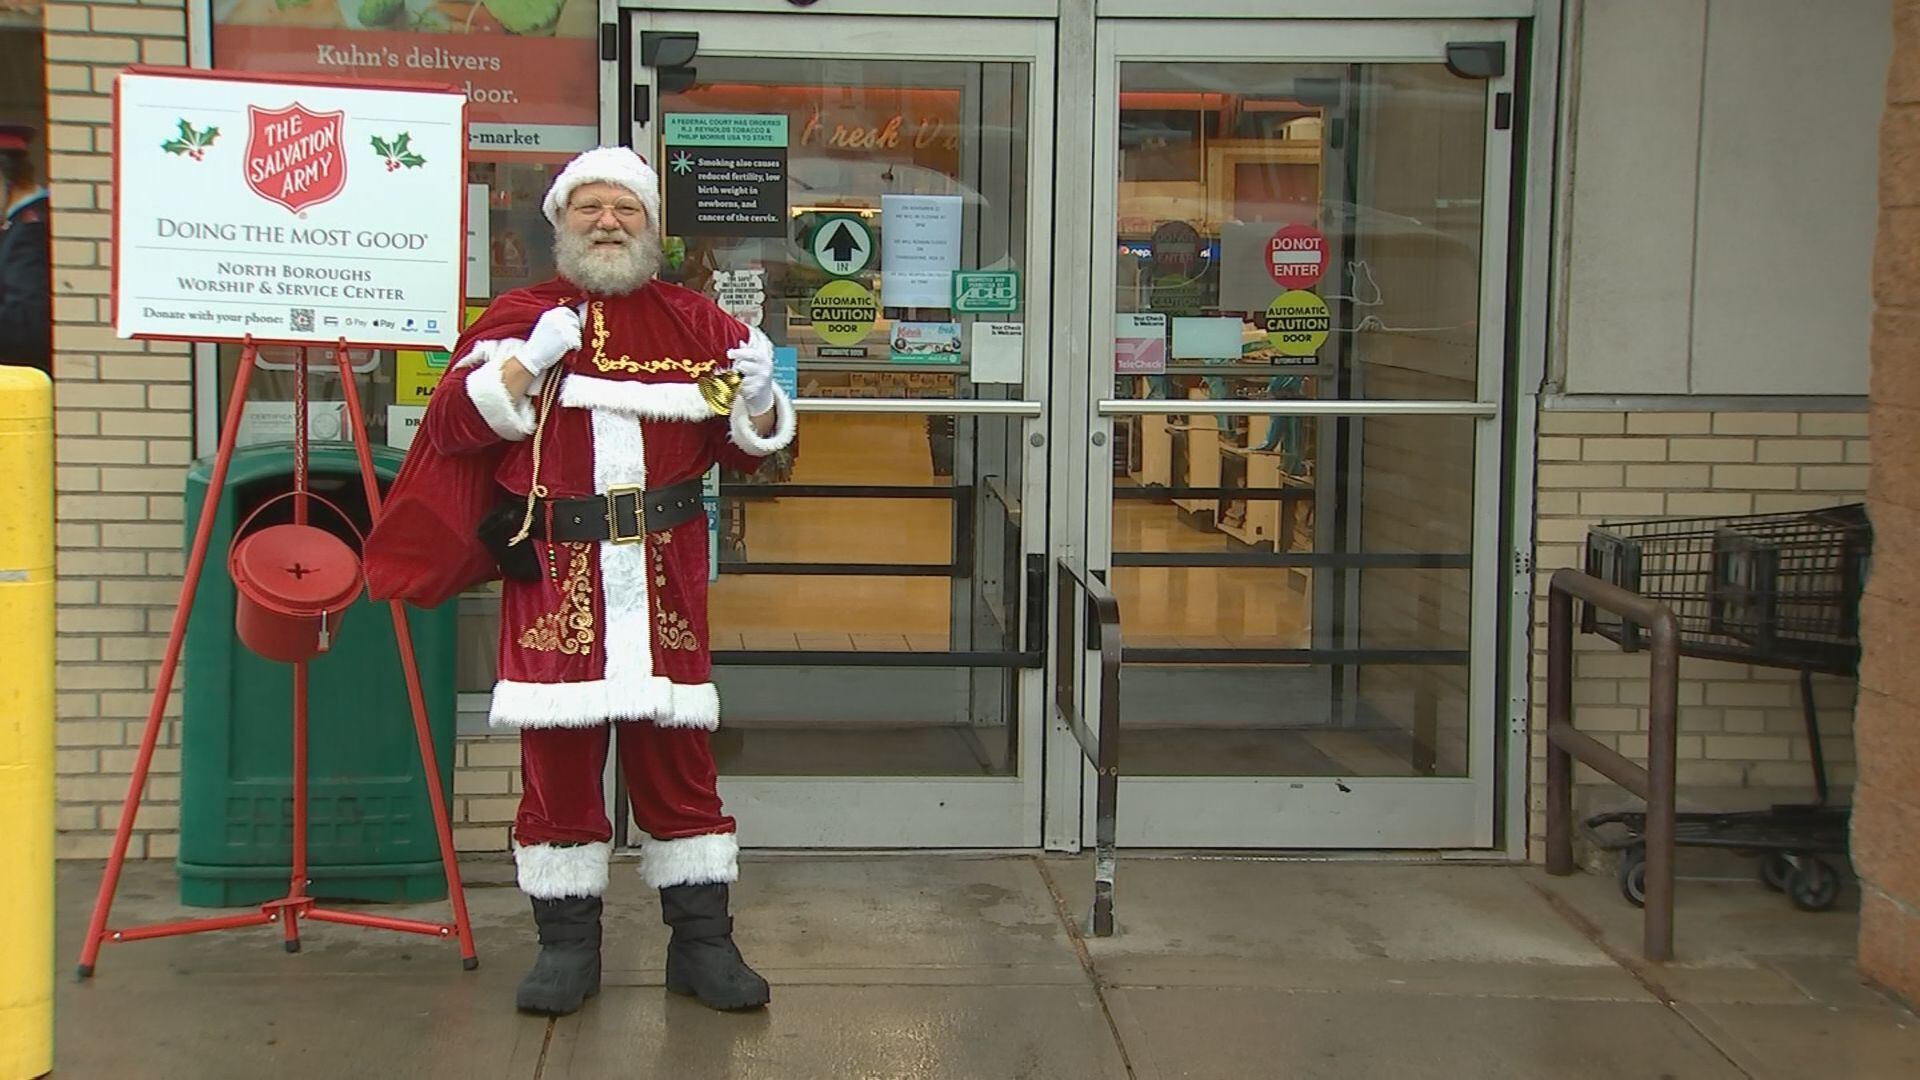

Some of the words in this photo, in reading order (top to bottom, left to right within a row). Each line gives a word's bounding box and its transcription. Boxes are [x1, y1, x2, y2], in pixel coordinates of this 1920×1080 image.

[316, 44, 400, 67] Kuhn's
[406, 46, 501, 71] delivers
[264, 116, 303, 147] THE
[800, 109, 902, 149] Fresh
[251, 122, 337, 183] SALVATION
[698, 158, 734, 169] Smoking
[736, 159, 752, 167] also
[753, 160, 780, 168] causes
[280, 152, 333, 199] ARMY
[698, 172, 730, 181] reduced
[731, 172, 765, 183] fertility,
[766, 173, 781, 181] low
[698, 186, 720, 194] birth
[720, 187, 749, 196] weight
[750, 186, 758, 194] in
[698, 200, 741, 209] newborns,
[741, 200, 757, 208] and
[726, 214, 736, 222] of
[736, 214, 749, 222] the
[750, 214, 779, 222] cervix.
[157, 218, 237, 241] DOING
[241, 225, 284, 243] THE
[290, 228, 352, 247] MOST
[1272, 237, 1293, 250] DO
[1294, 238, 1322, 249] NOT
[217, 262, 277, 277] NORTH
[283, 265, 372, 282] BOROUGHS
[836, 262, 850, 272] IN
[1274, 265, 1319, 276] ENTER
[177, 277, 255, 293] WORSHIP
[259, 281, 272, 294] &
[276, 281, 338, 297] SERVICE
[343, 285, 405, 300] CENTER
[965, 287, 1014, 299] ACHD
[813, 296, 872, 306] AUTOMATIC
[812, 307, 875, 321] CAUTION
[1267, 305, 1326, 316] AUTOMATIC
[143, 307, 186, 320] Donate
[188, 310, 214, 321] with
[217, 313, 243, 324] your
[245, 312, 284, 326] phone:
[380, 319, 395, 329] Pay
[828, 324, 858, 334] DOOR
[1266, 318, 1329, 331] CAUTION
[1282, 333, 1312, 343] DOOR
[1118, 359, 1163, 369] TeleCheck
